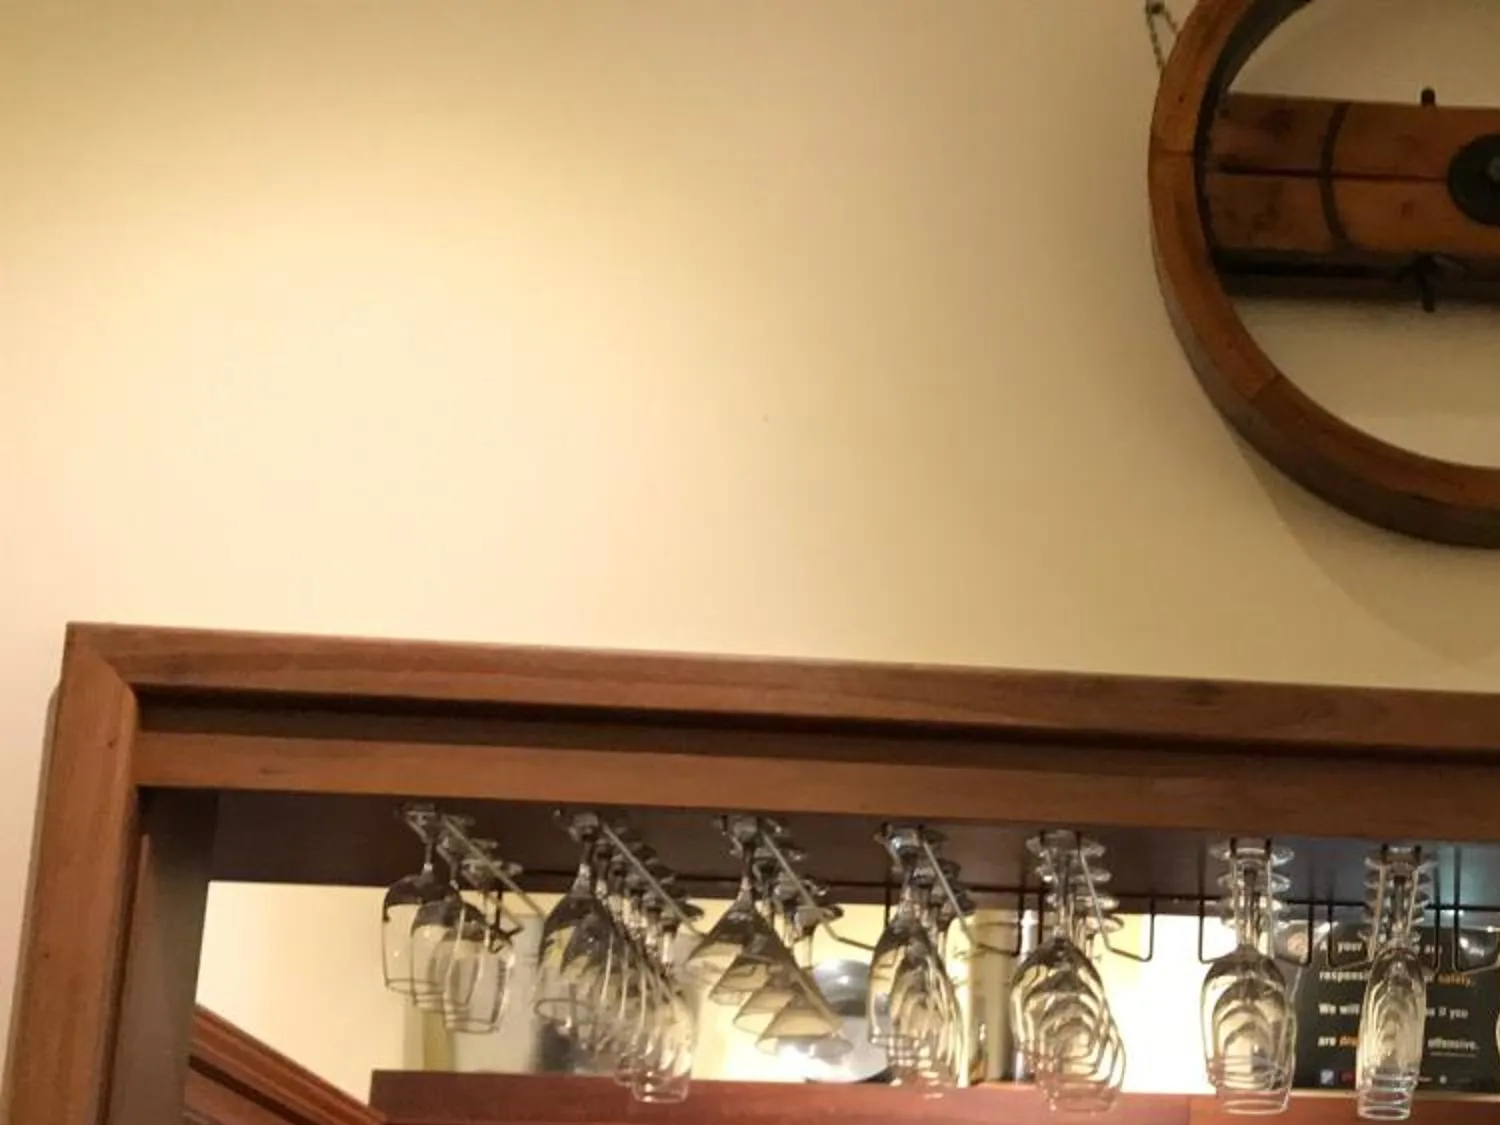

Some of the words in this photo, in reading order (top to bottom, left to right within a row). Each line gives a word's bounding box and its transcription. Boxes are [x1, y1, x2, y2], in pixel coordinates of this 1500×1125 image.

[1318, 1003, 1336, 1015] We
[1450, 1009, 1469, 1020] you
[1317, 1036, 1336, 1048] are
